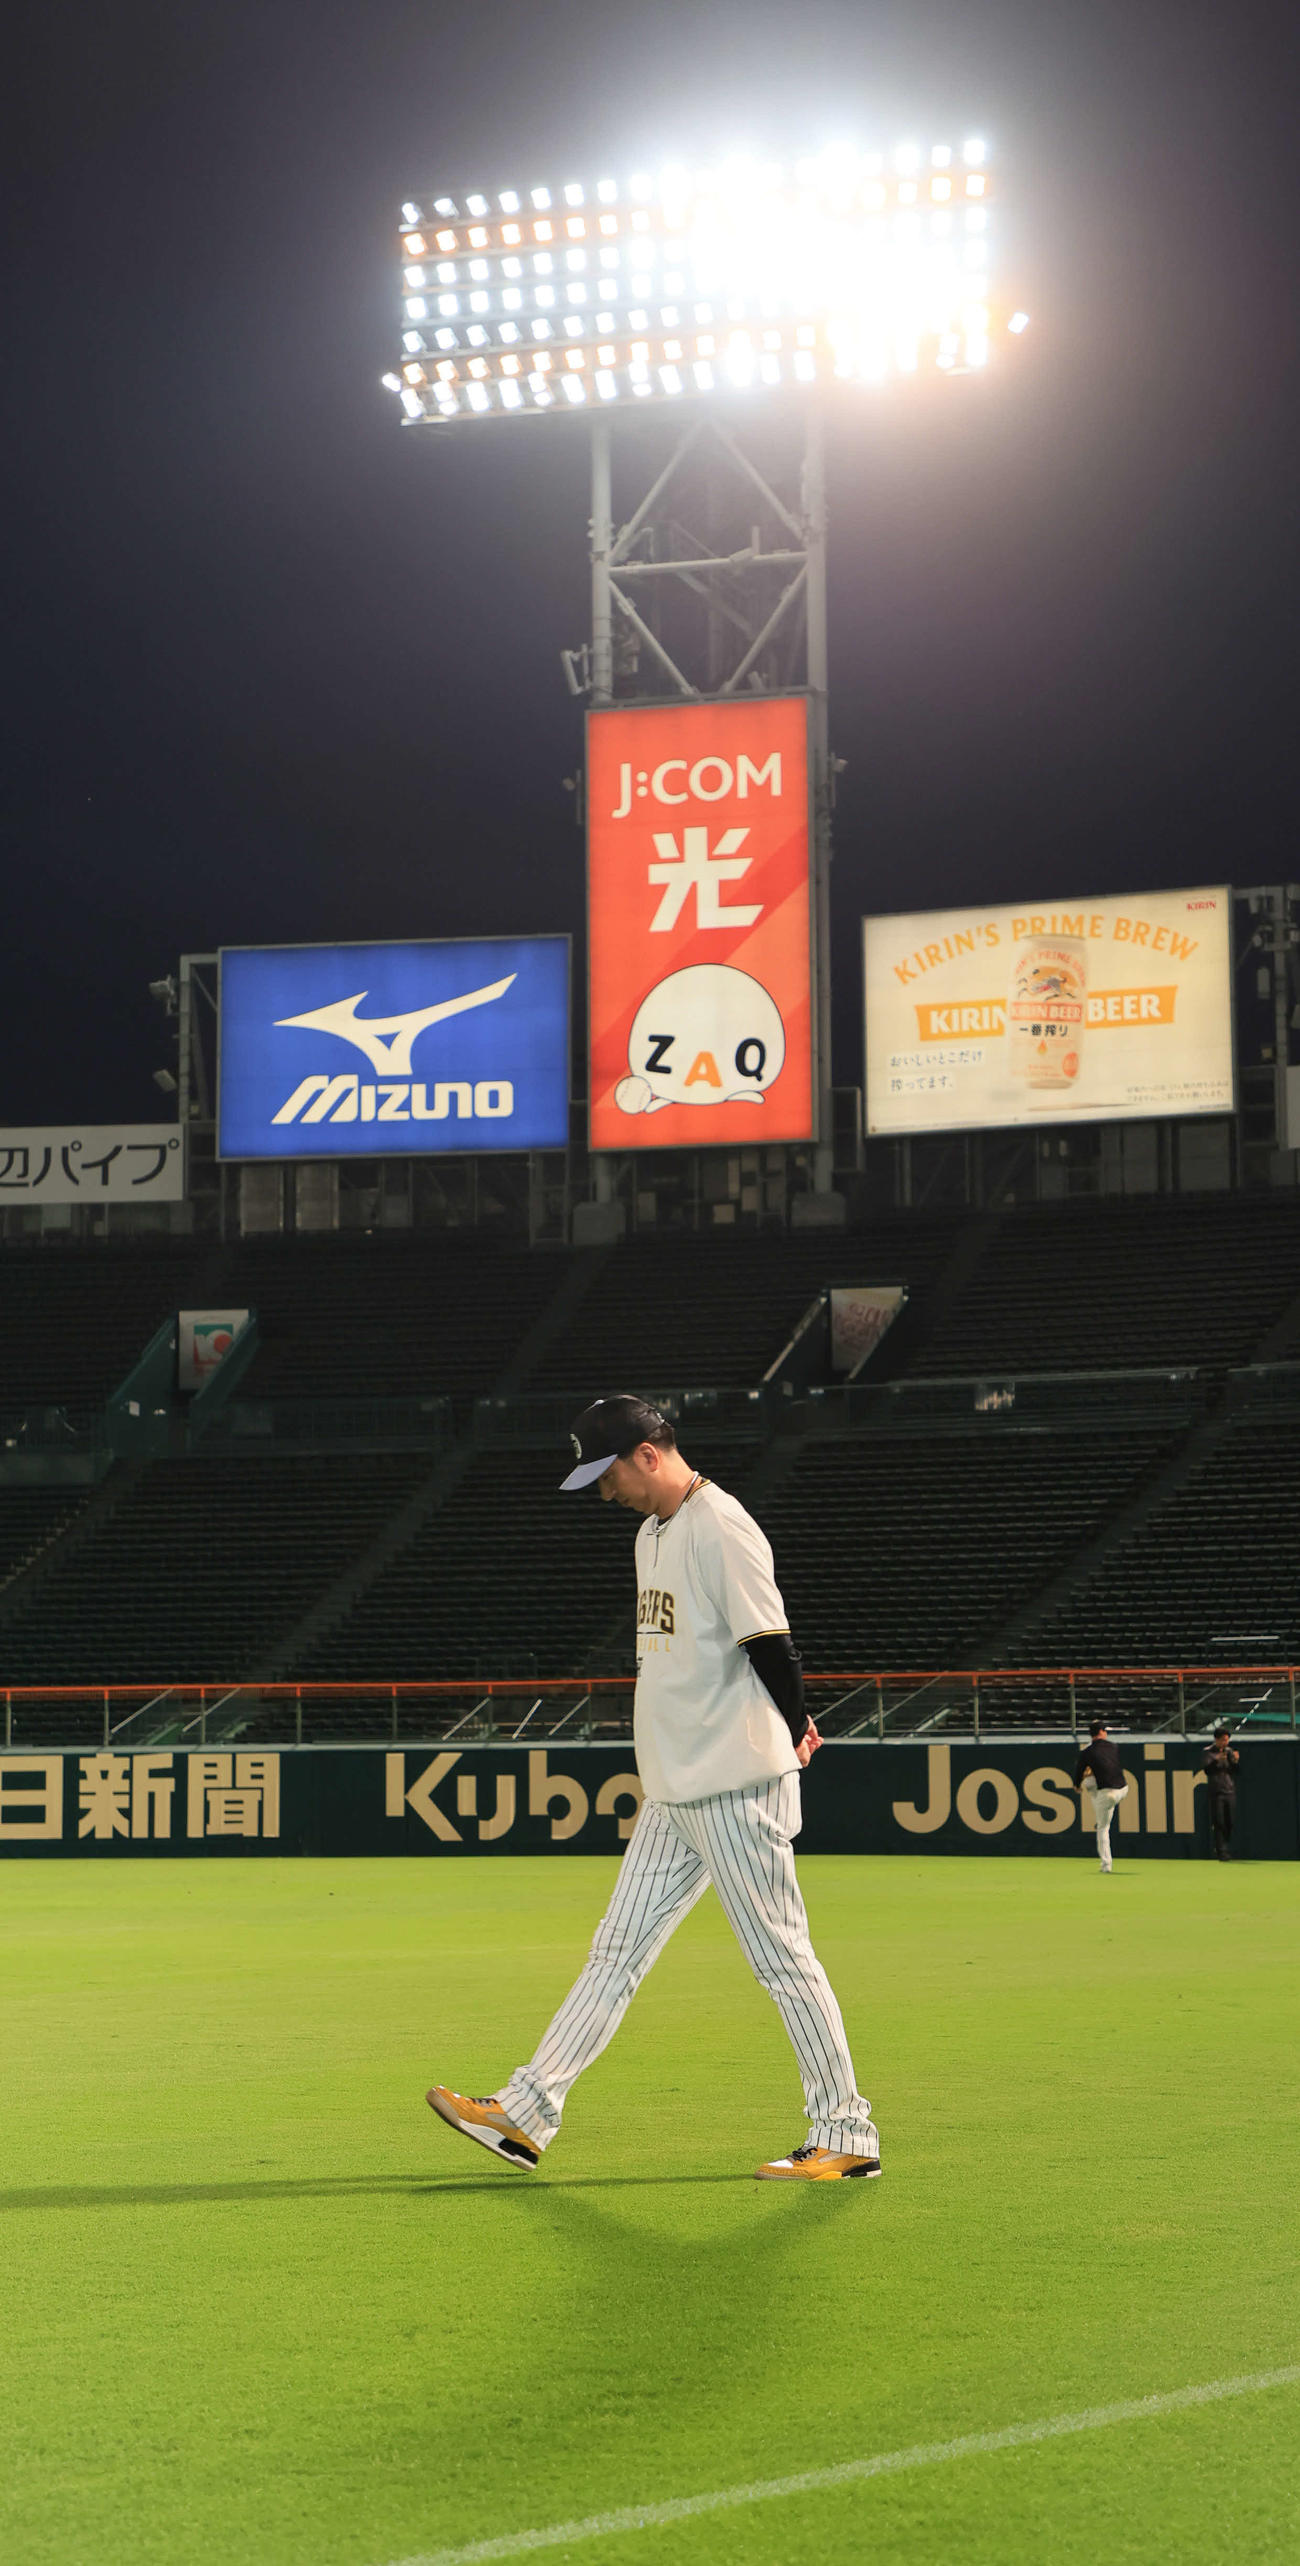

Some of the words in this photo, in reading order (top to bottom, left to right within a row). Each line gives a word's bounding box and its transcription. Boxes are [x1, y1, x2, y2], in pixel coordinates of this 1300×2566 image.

[612, 752, 782, 818] J:COM
[648, 826, 765, 932] 光
[893, 923, 1000, 985] KIRIN'S
[1012, 914, 1104, 941] PRIME
[1114, 917, 1199, 961] BREW
[1087, 994, 1162, 1022] BEER
[0, 1752, 280, 1838] 日新聞
